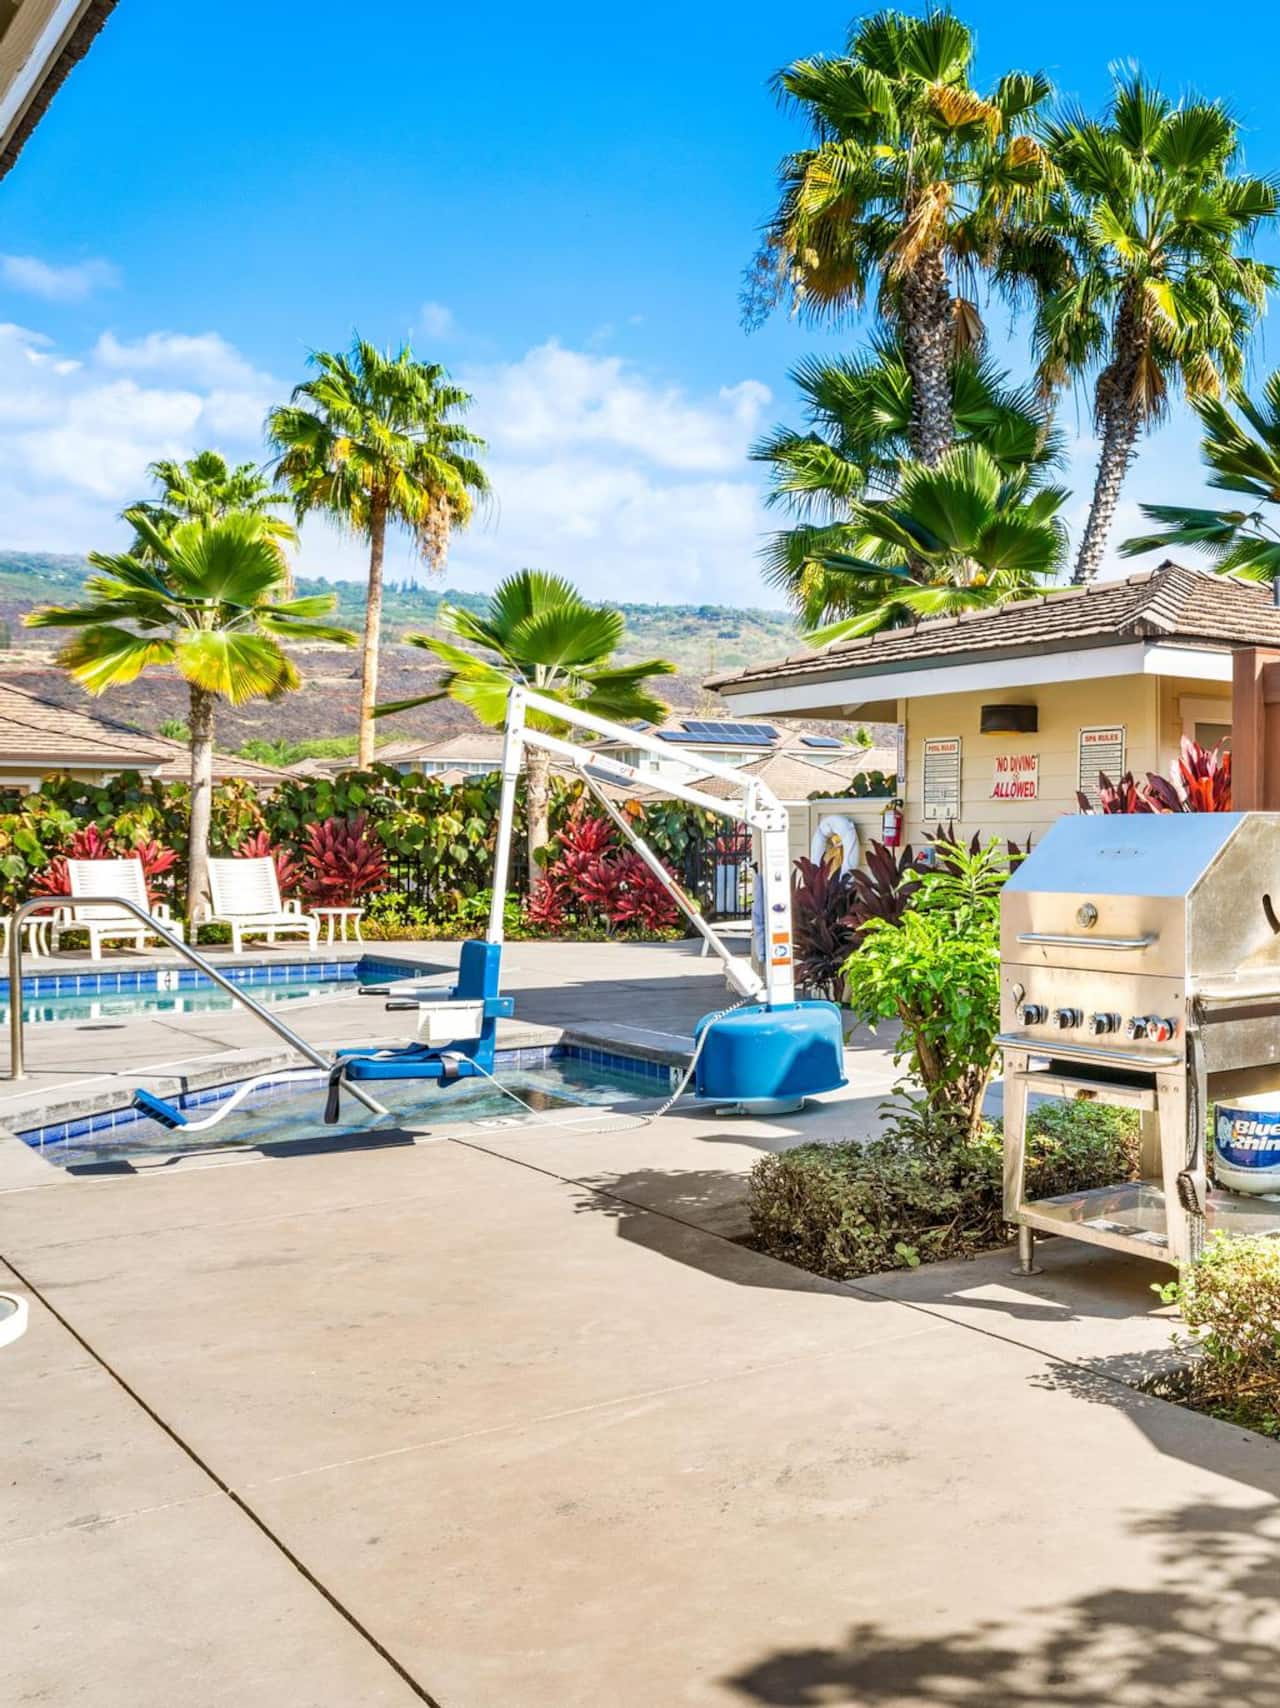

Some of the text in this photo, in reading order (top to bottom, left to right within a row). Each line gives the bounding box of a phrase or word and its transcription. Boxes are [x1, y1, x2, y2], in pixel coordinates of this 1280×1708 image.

[996, 754, 1035, 772] NO DIVING
[992, 782, 1035, 798] ALLOWED
